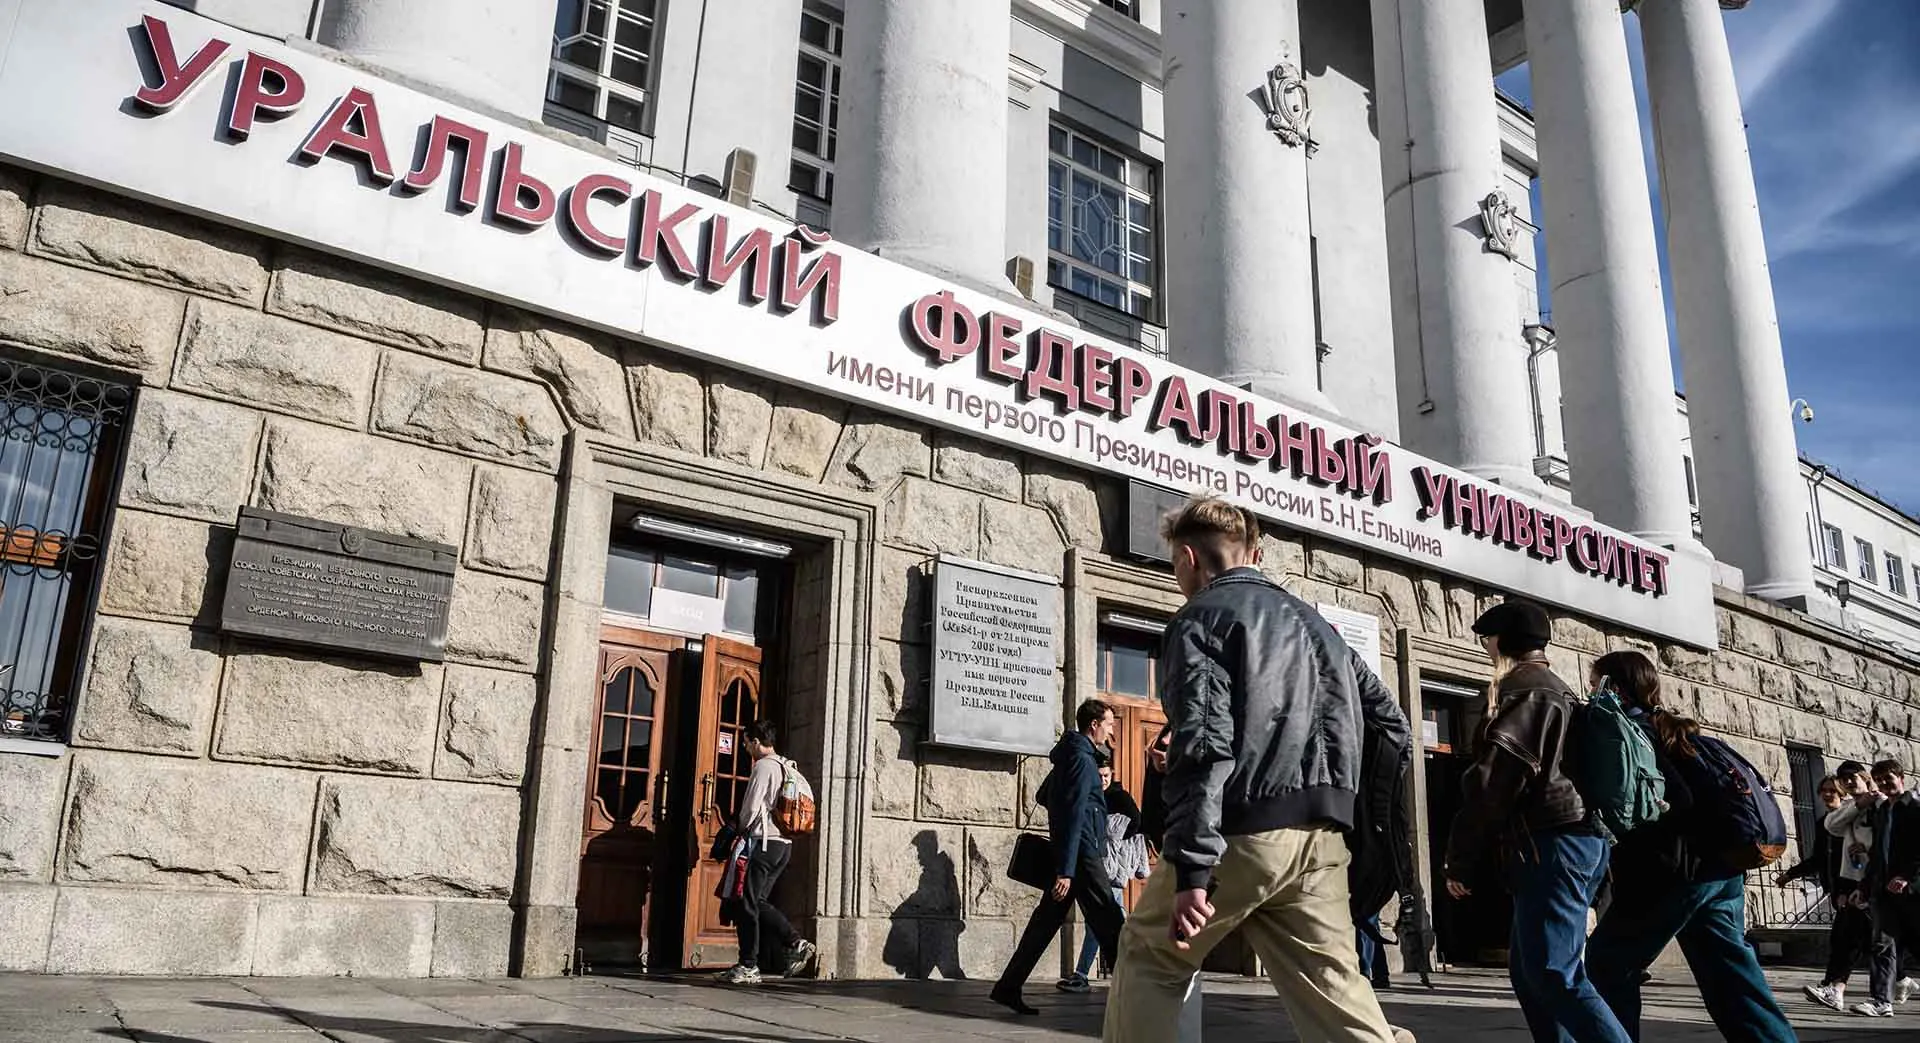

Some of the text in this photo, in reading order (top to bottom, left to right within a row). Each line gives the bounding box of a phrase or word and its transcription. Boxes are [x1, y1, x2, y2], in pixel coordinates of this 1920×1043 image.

[130, 14, 1670, 597] УРАЛЬСКИЙ ФЕДЕРАЛЬНЫЙ УНИВЕРСИТЕТ
[827, 350, 1443, 558] имени первого Президента России Б.Н.Ельцина
[269, 566, 318, 583] СОВЕТСКИХ
[386, 574, 418, 588] СОВЕТА
[956, 580, 1039, 606] Распоряжением
[956, 594, 1038, 620] Правительства
[940, 605, 1052, 636] Российской Федерации
[971, 640, 995, 652] 2008
[940, 649, 1052, 676] УГТУ-УПИ присвоено
[945, 679, 1046, 704] Президента России
[964, 670, 1028, 688] имя первого
